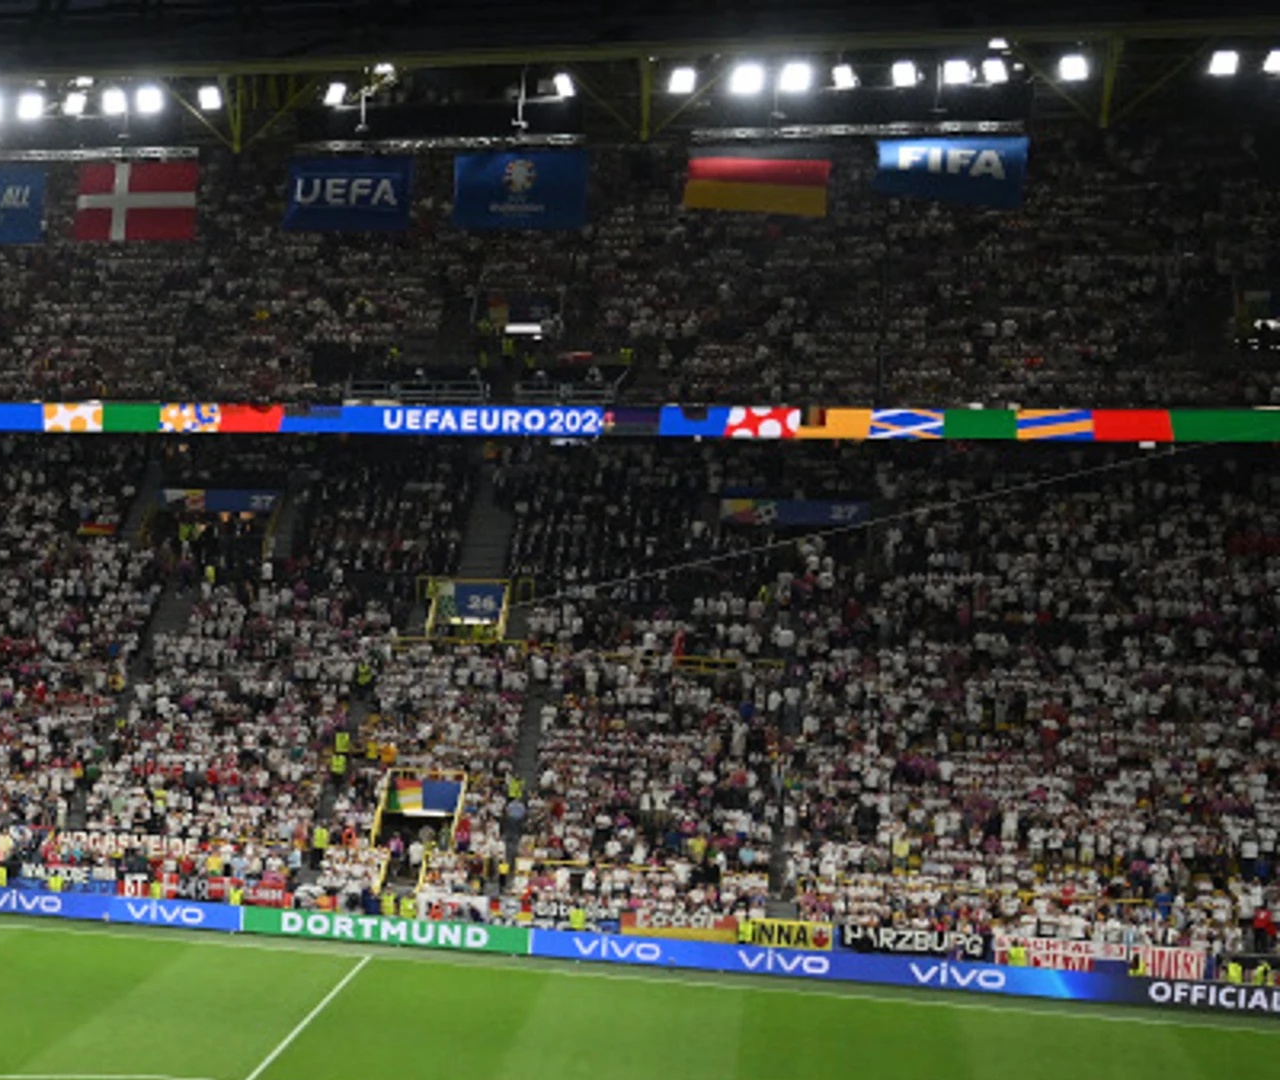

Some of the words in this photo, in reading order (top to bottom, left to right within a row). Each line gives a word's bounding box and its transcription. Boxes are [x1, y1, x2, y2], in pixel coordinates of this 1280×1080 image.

[897, 144, 1007, 181] FIFA
[294, 177, 399, 206] UEFA
[126, 900, 206, 926] vivo
[280, 911, 490, 949] DORTMUND
[572, 935, 662, 962] vivo
[738, 948, 831, 975] vivo
[909, 962, 1006, 990] vivo
[1148, 980, 1280, 1012] OFFICIAL
